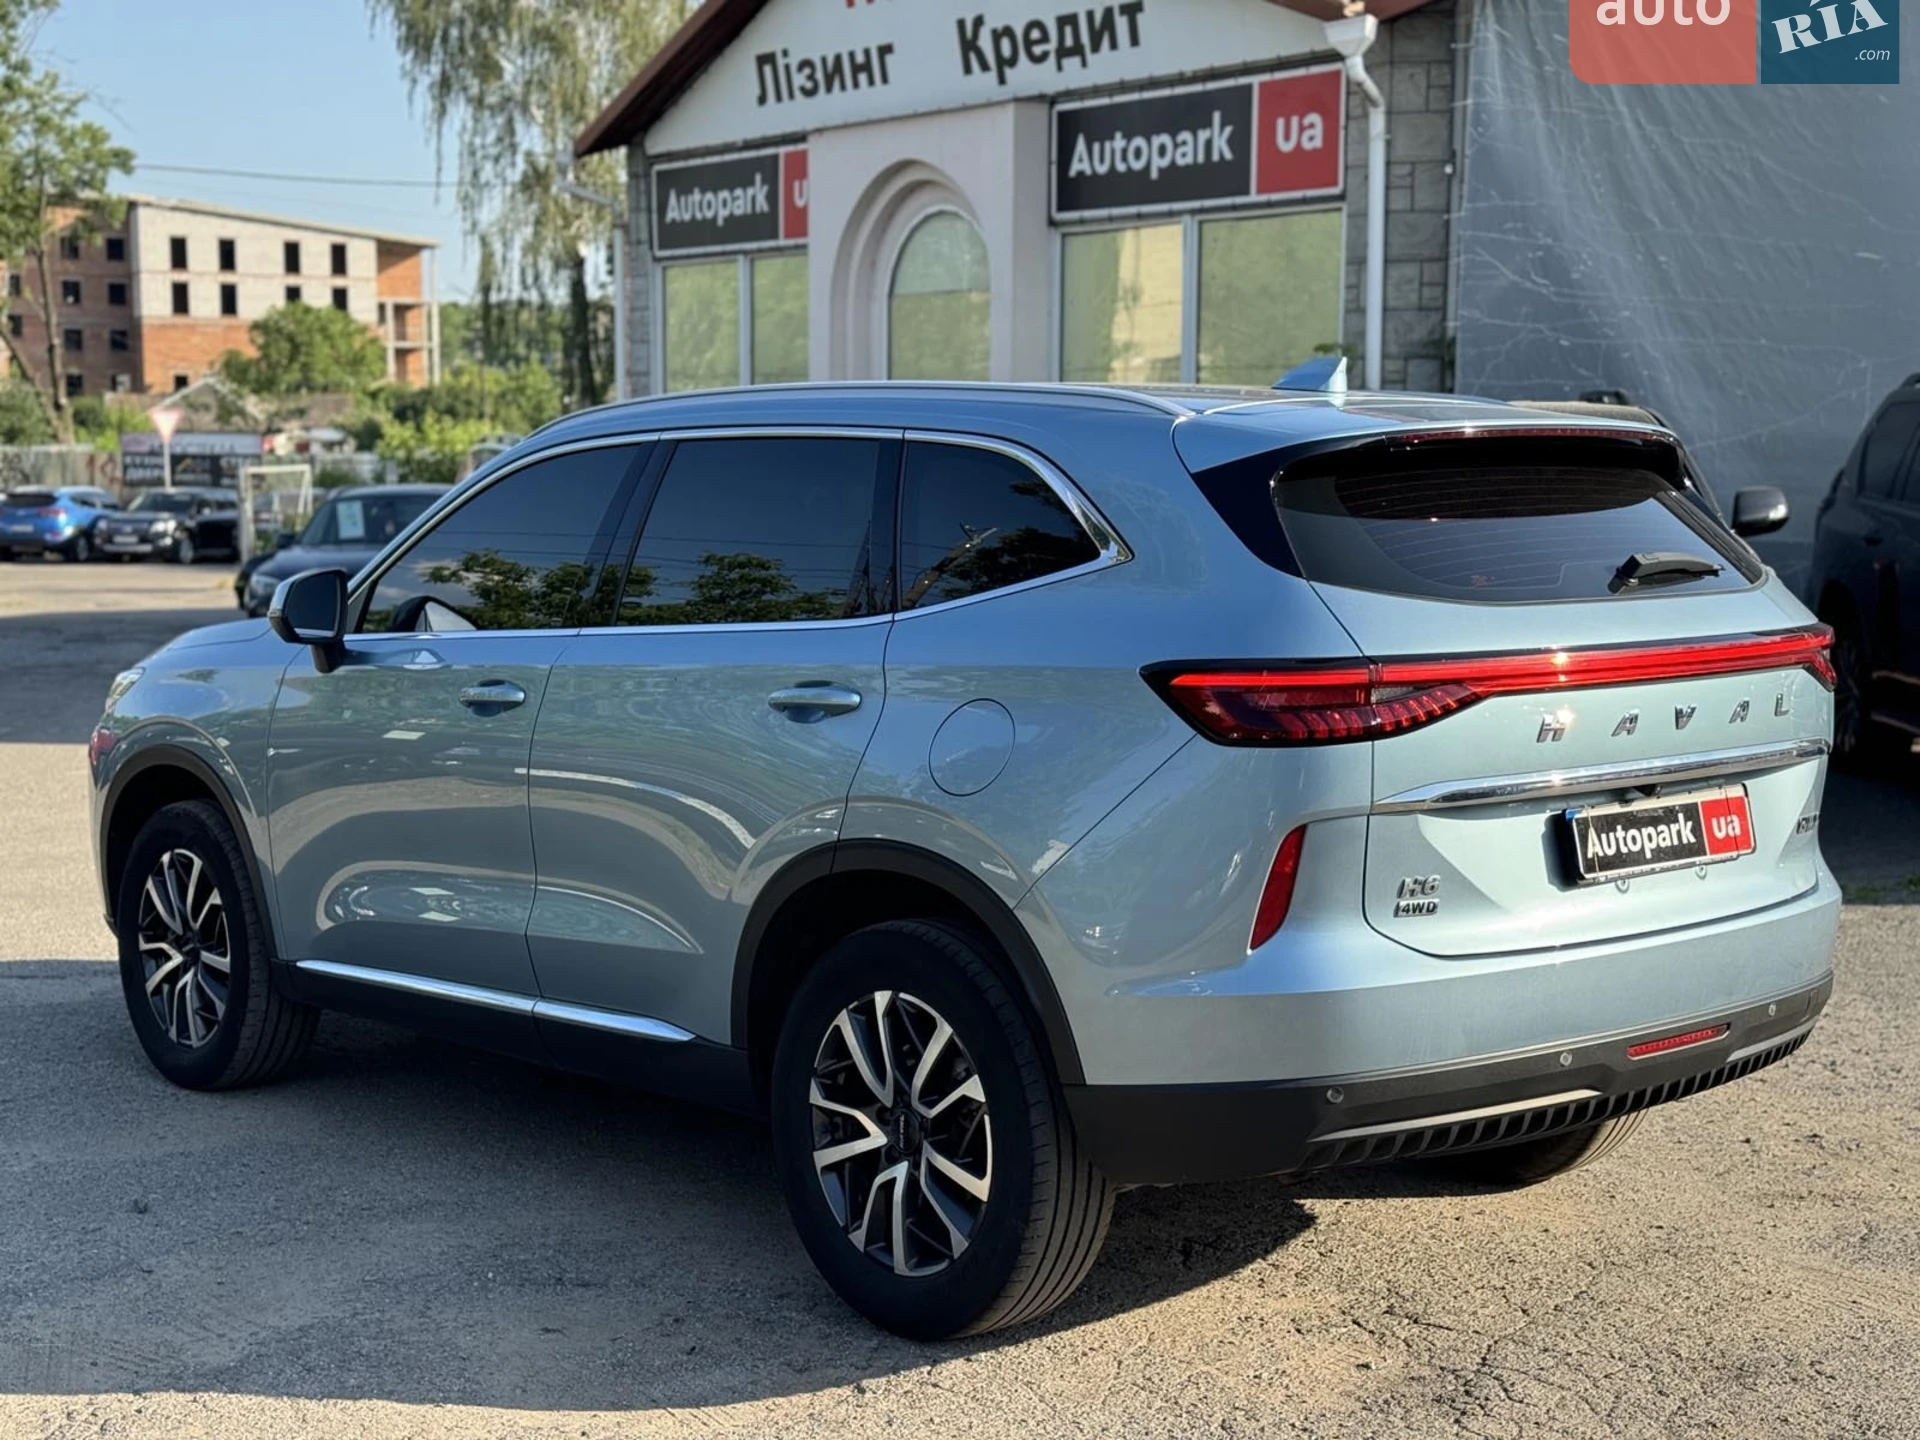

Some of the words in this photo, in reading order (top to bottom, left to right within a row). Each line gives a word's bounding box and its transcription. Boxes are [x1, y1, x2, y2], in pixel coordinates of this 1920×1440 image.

[755, 43, 895, 107] Лізинг
[956, 1, 1145, 86] Кредит
[1067, 110, 1234, 180] Autopark
[1275, 111, 1324, 153] ua
[665, 172, 770, 228] Autopark
[1536, 692, 1790, 743] HAVAL
[1586, 812, 1698, 860] Autopark
[1710, 813, 1742, 840] ua
[1400, 900, 1438, 915] 4WD
